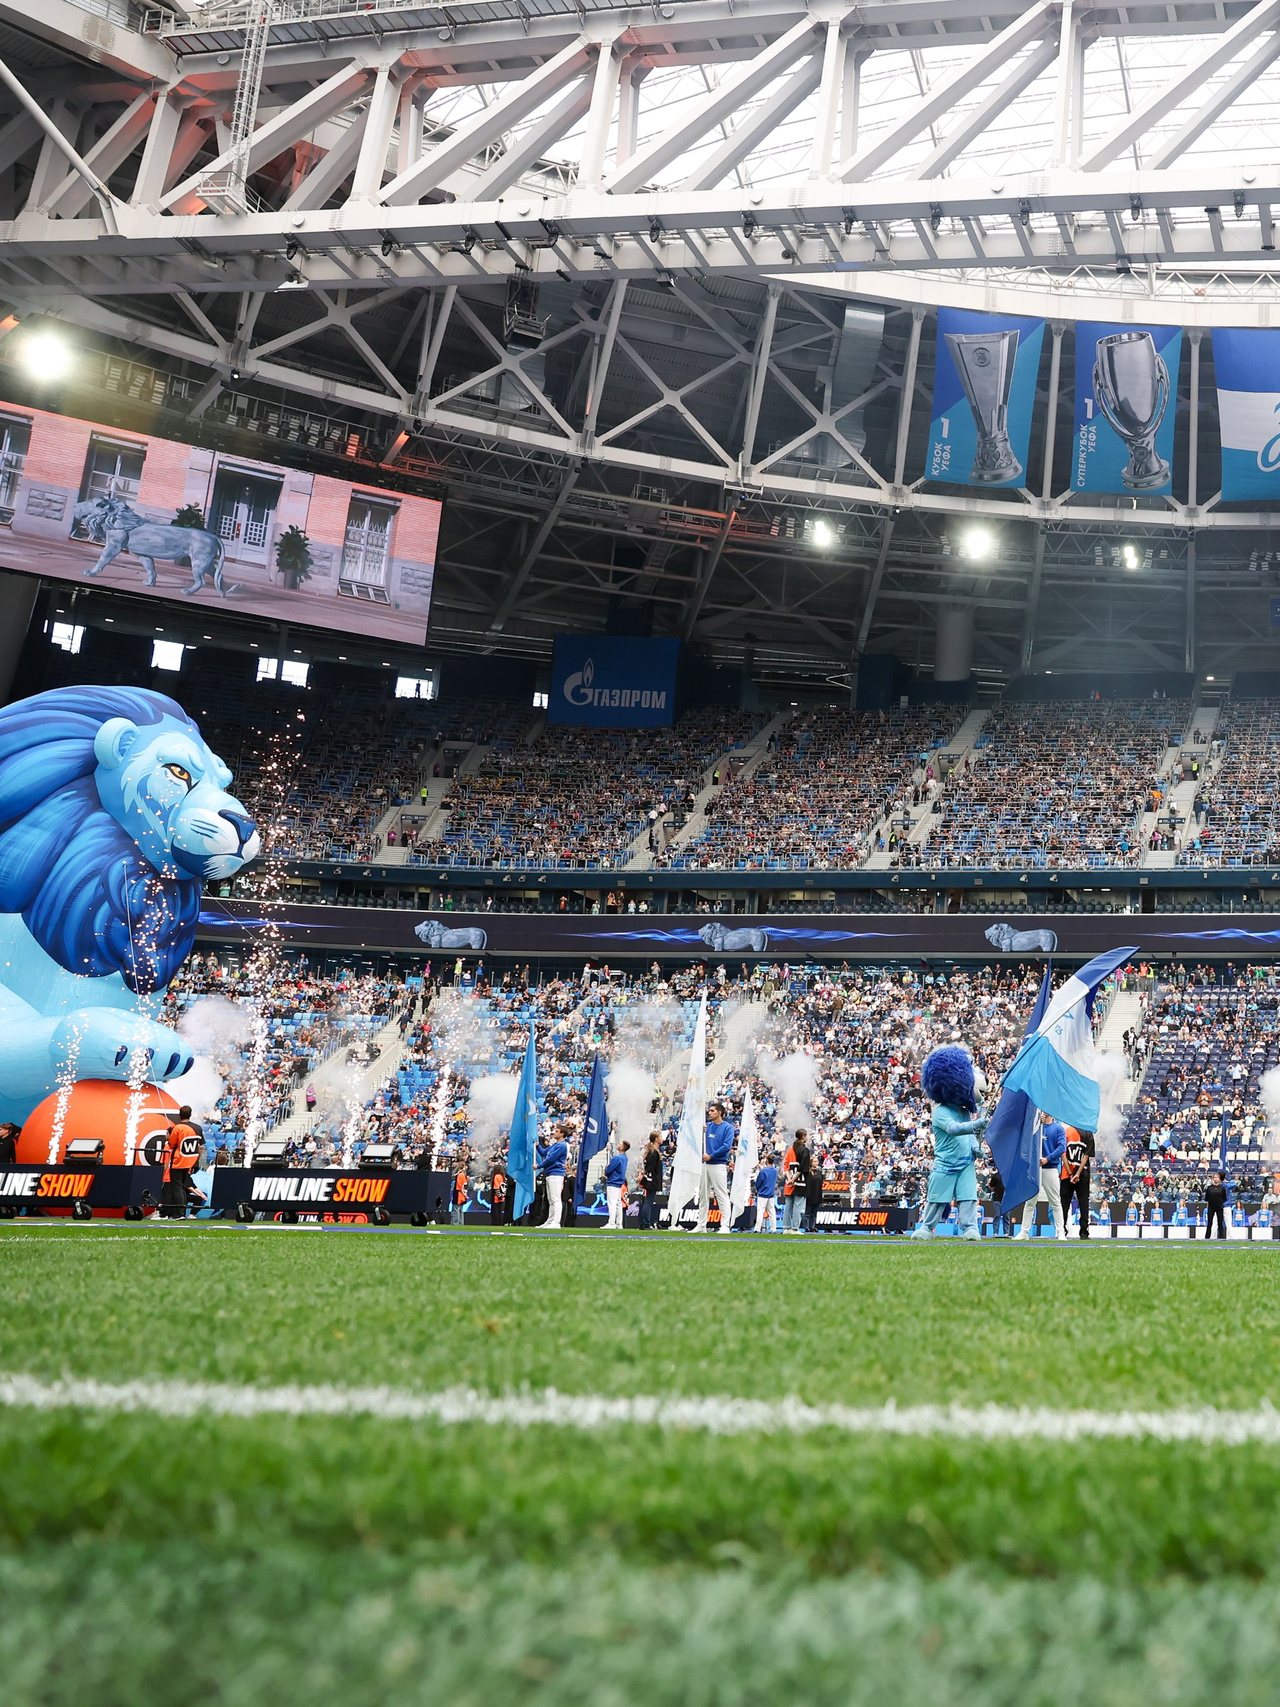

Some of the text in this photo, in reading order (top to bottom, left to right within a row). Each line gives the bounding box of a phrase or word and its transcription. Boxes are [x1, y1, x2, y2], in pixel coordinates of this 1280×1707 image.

[1084, 398, 1093, 419] 1
[941, 417, 950, 439] 1
[1088, 426, 1097, 453] УЕФА
[931, 442, 943, 476] КУБОК
[941, 445, 951, 471] УЕФА
[1077, 424, 1088, 487] СУПЕРКУБОК
[593, 689, 666, 709] ГАЗПРОМ
[37, 1173, 95, 1198] SHOW
[251, 1177, 391, 1203] WINLINE SHOW
[816, 1211, 888, 1226] WINLINE SHOW
